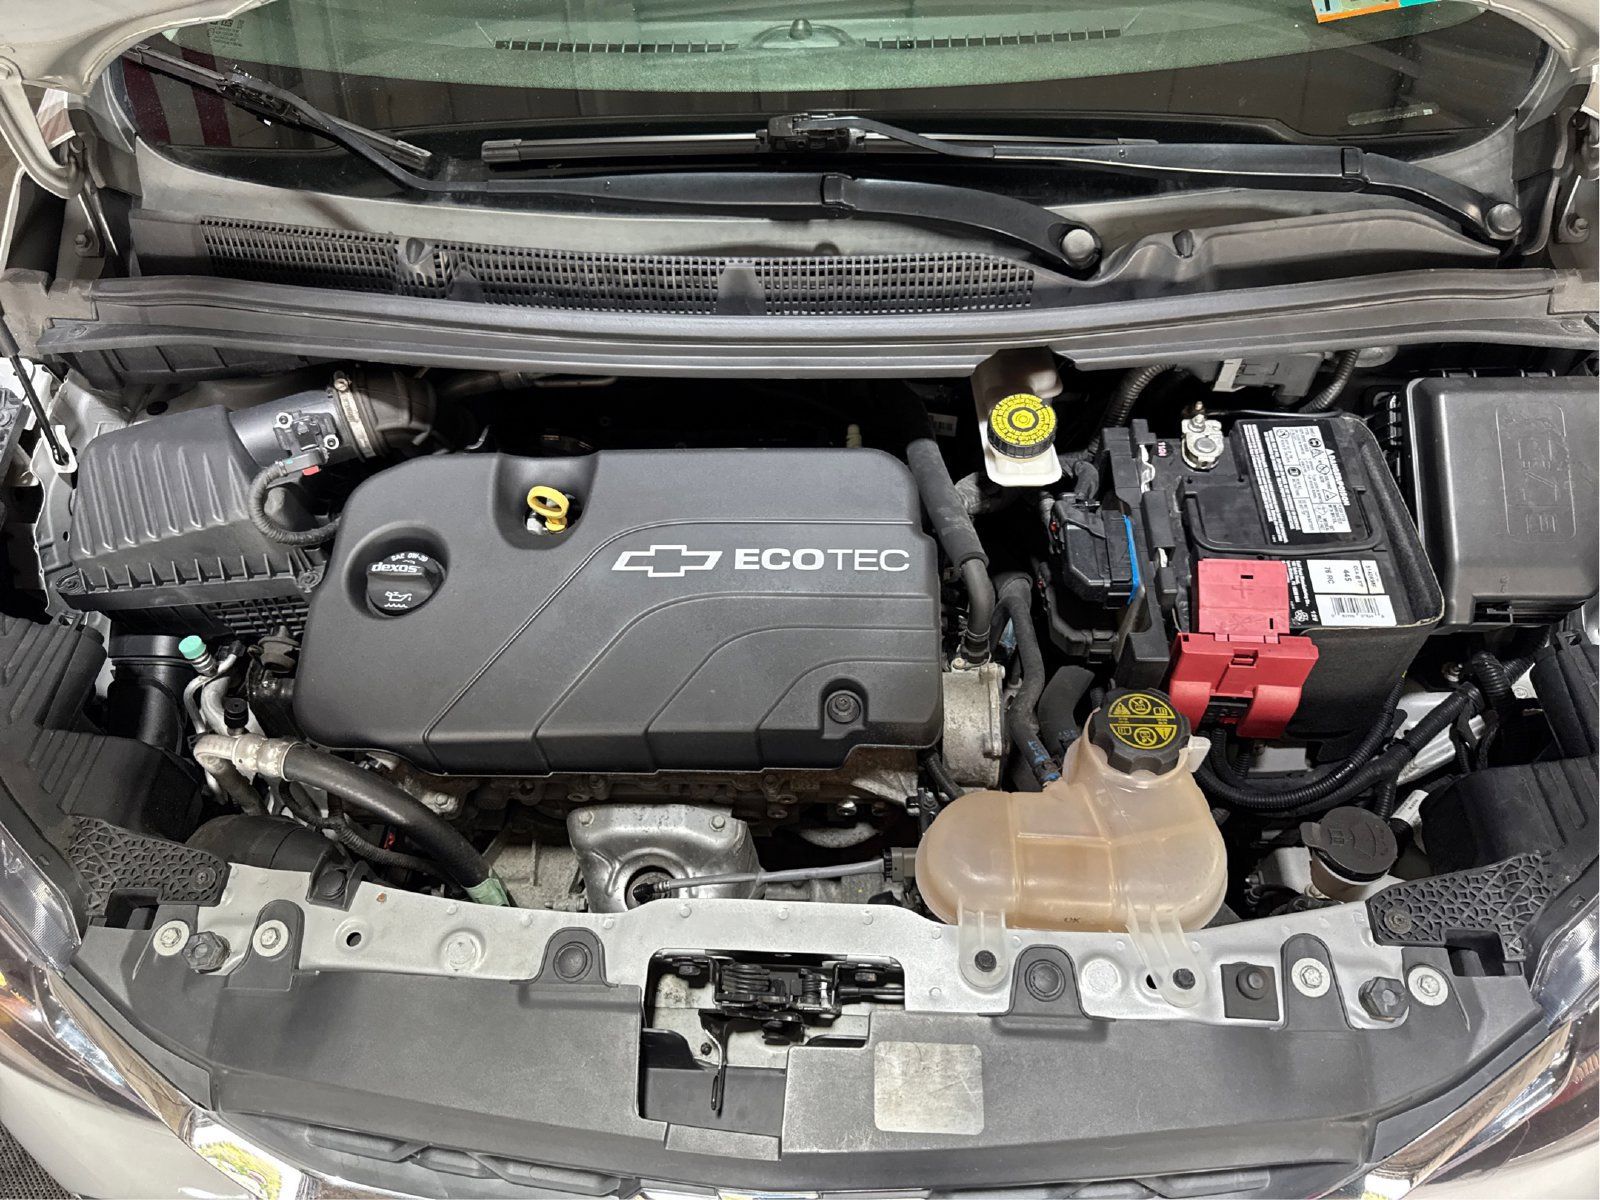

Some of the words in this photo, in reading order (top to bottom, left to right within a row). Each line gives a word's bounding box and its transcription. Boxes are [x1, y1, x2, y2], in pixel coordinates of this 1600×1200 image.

[734, 548, 910, 572] ECOTEC
[371, 562, 420, 573] dexos
[1343, 569, 1352, 582] 445
